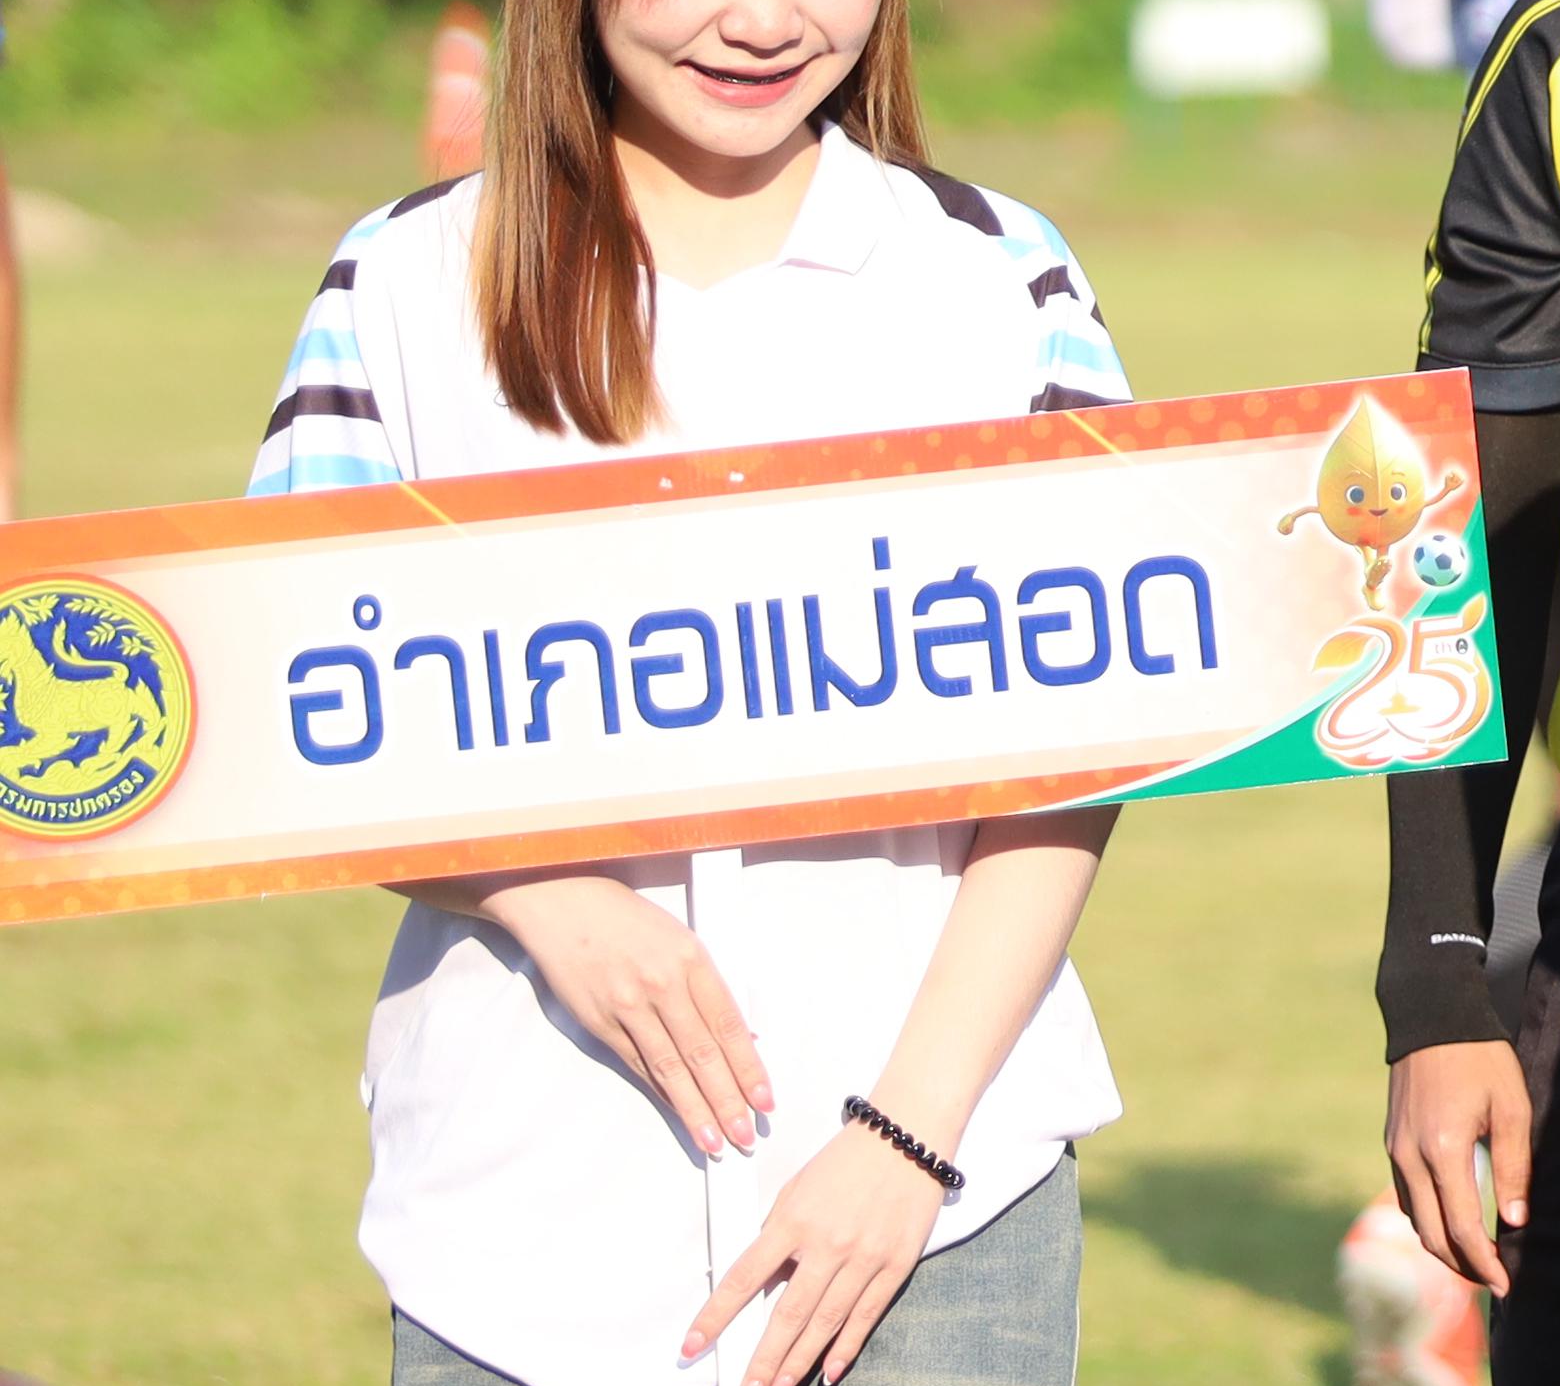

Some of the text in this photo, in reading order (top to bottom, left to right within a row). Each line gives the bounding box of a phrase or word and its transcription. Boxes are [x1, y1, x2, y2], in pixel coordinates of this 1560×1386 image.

[286, 535, 1220, 767] อำเภอแม่สอด
